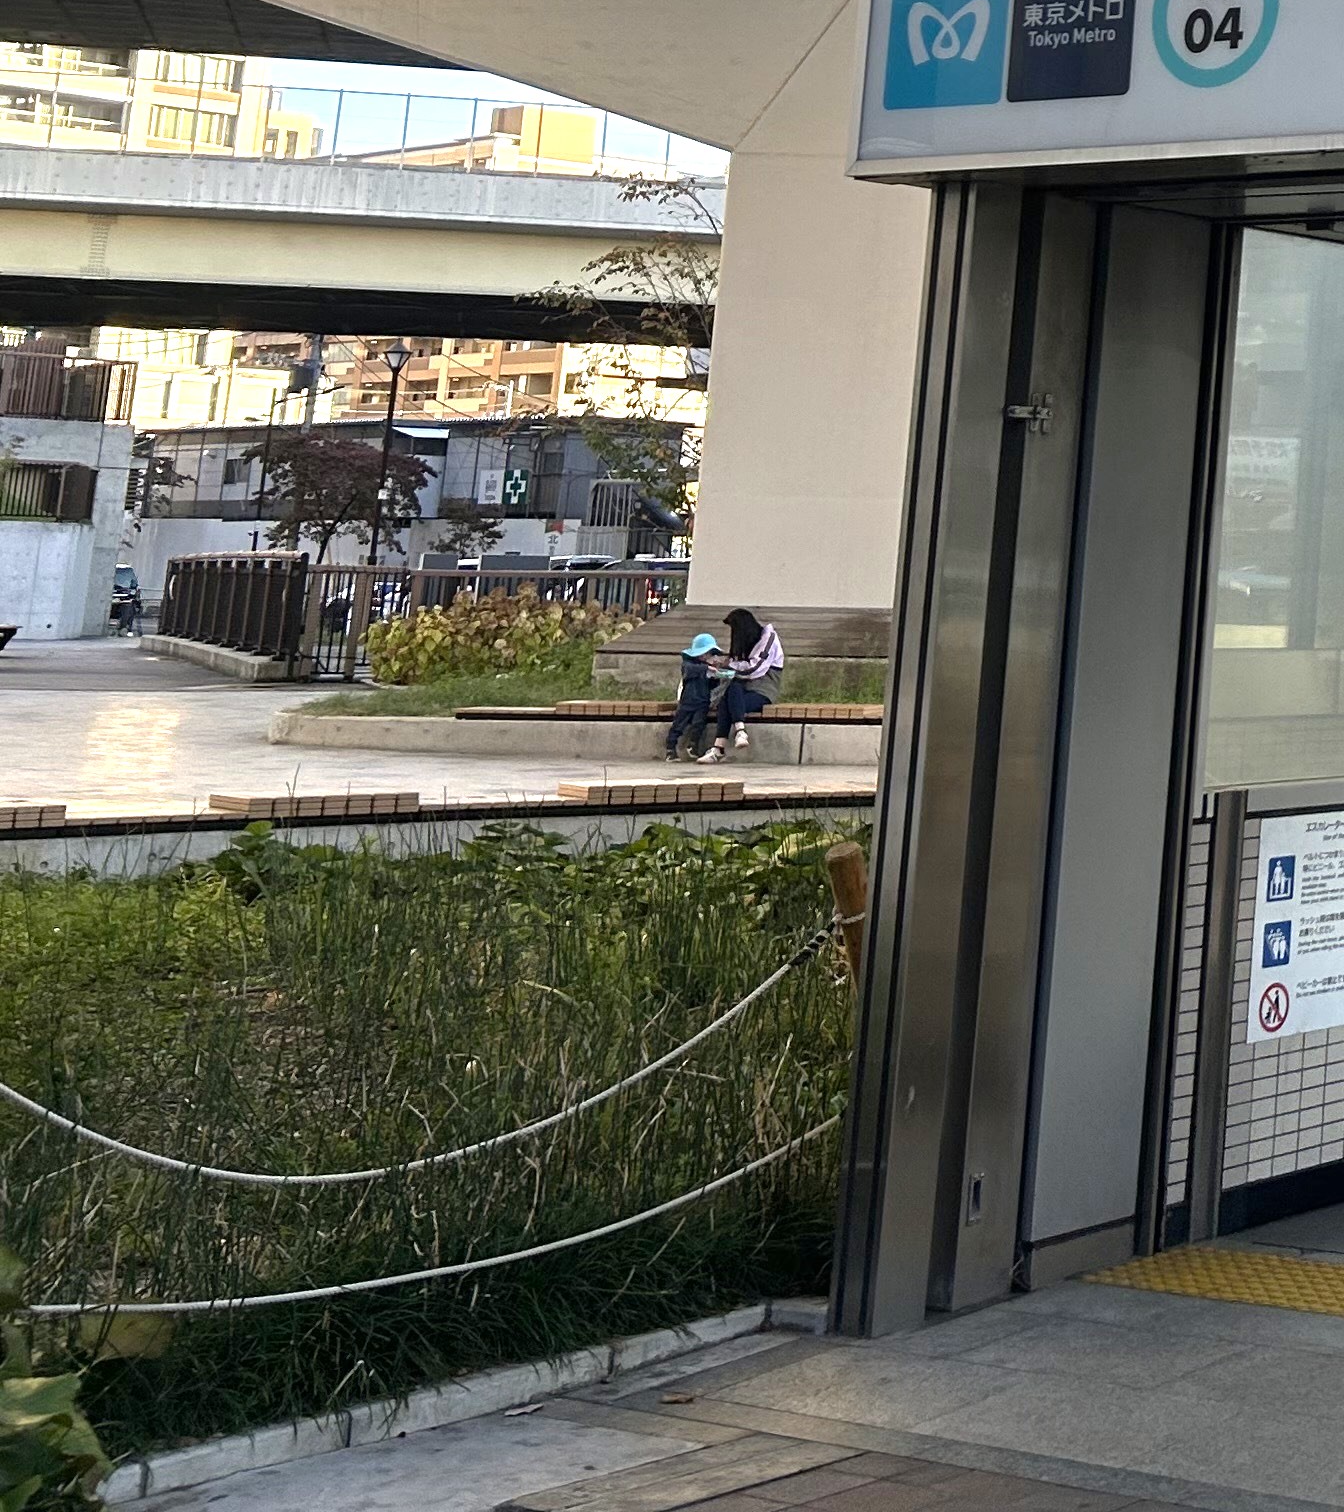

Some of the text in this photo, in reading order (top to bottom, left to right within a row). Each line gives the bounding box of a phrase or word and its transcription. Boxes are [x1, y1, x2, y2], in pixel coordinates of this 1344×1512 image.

[1028, 26, 1116, 49] Tokyo Metro
[1184, 7, 1243, 54] 04
